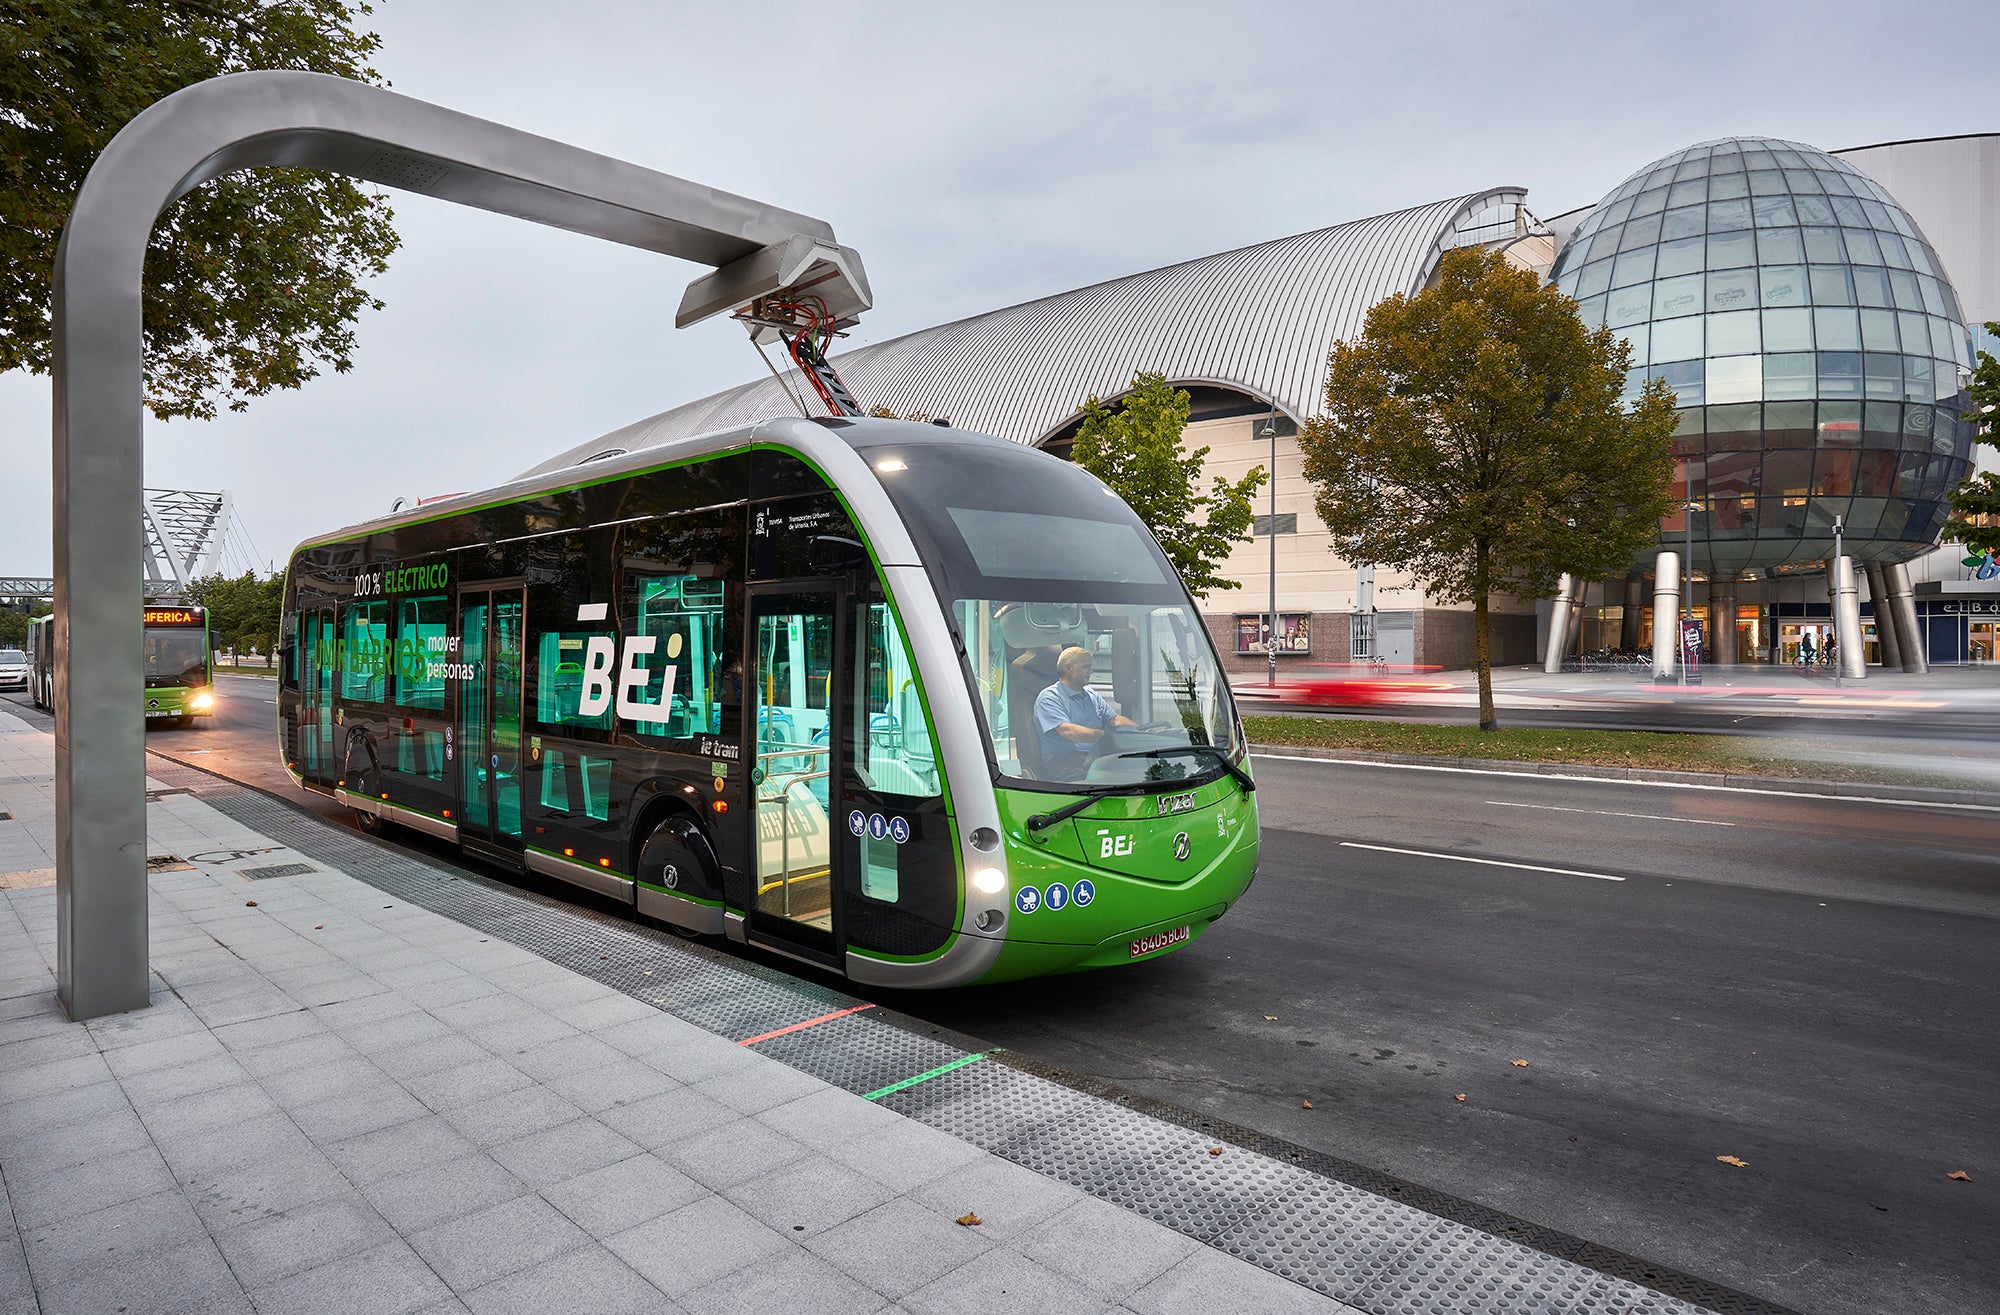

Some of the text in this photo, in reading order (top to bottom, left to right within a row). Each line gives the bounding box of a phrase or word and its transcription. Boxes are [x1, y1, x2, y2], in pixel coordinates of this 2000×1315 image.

[353, 562, 448, 597] 100 % ELÉCTRICO
[427, 635, 461, 653] mover
[315, 638, 427, 680] UNIR BARRIOS
[426, 661, 475, 682] personas
